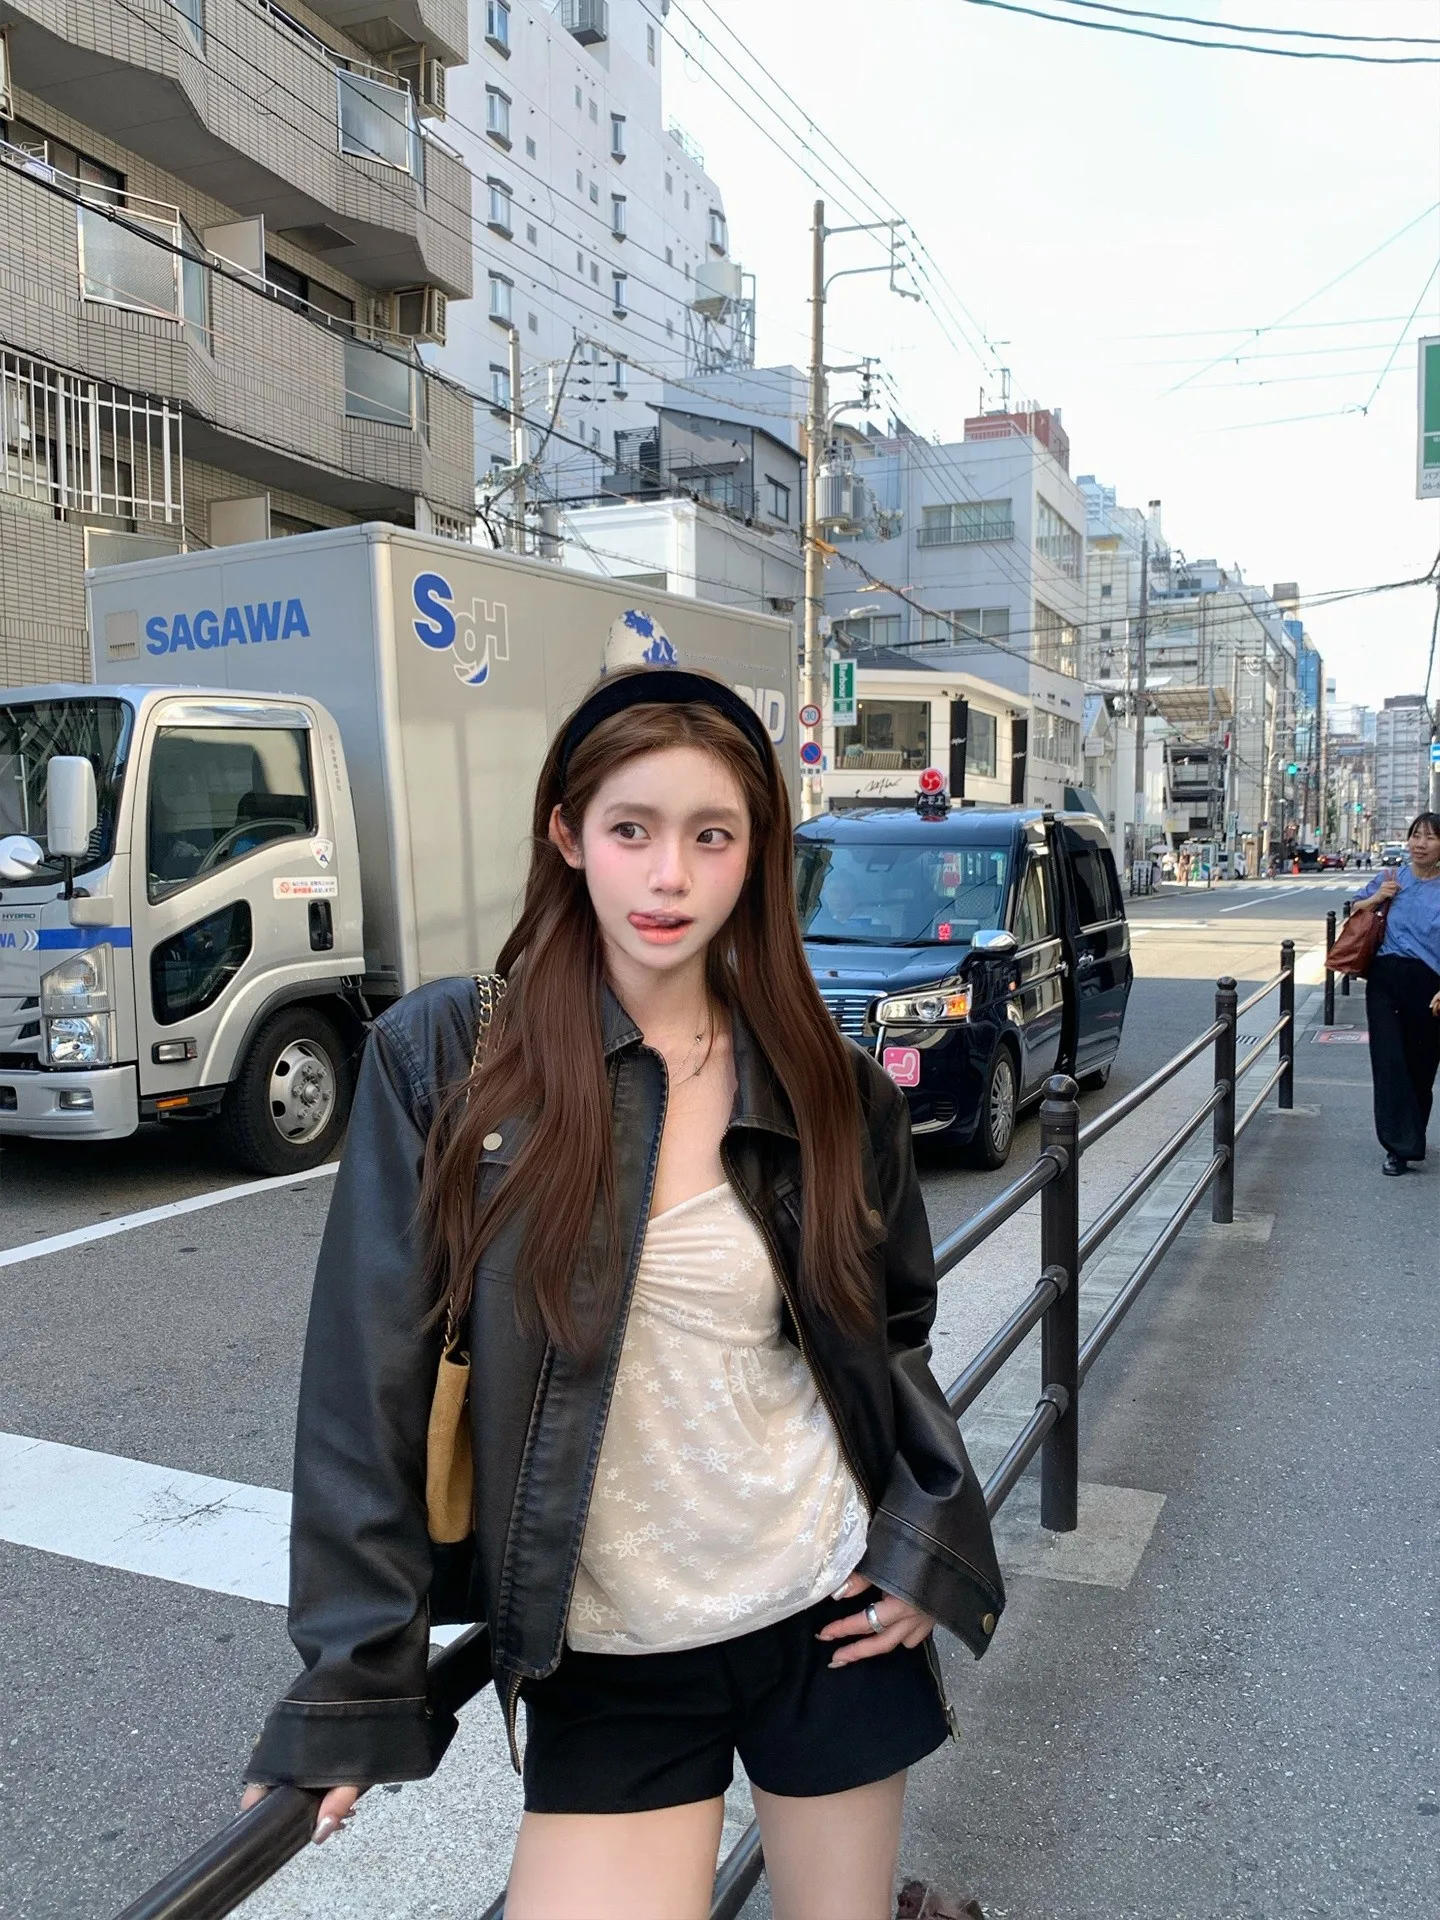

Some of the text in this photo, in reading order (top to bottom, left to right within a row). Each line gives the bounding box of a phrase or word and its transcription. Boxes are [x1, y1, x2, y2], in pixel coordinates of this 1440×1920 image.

[145, 598, 310, 656] SAGAWA
[804, 710, 817, 721] 30
[917, 795, 944, 805] トモエ
